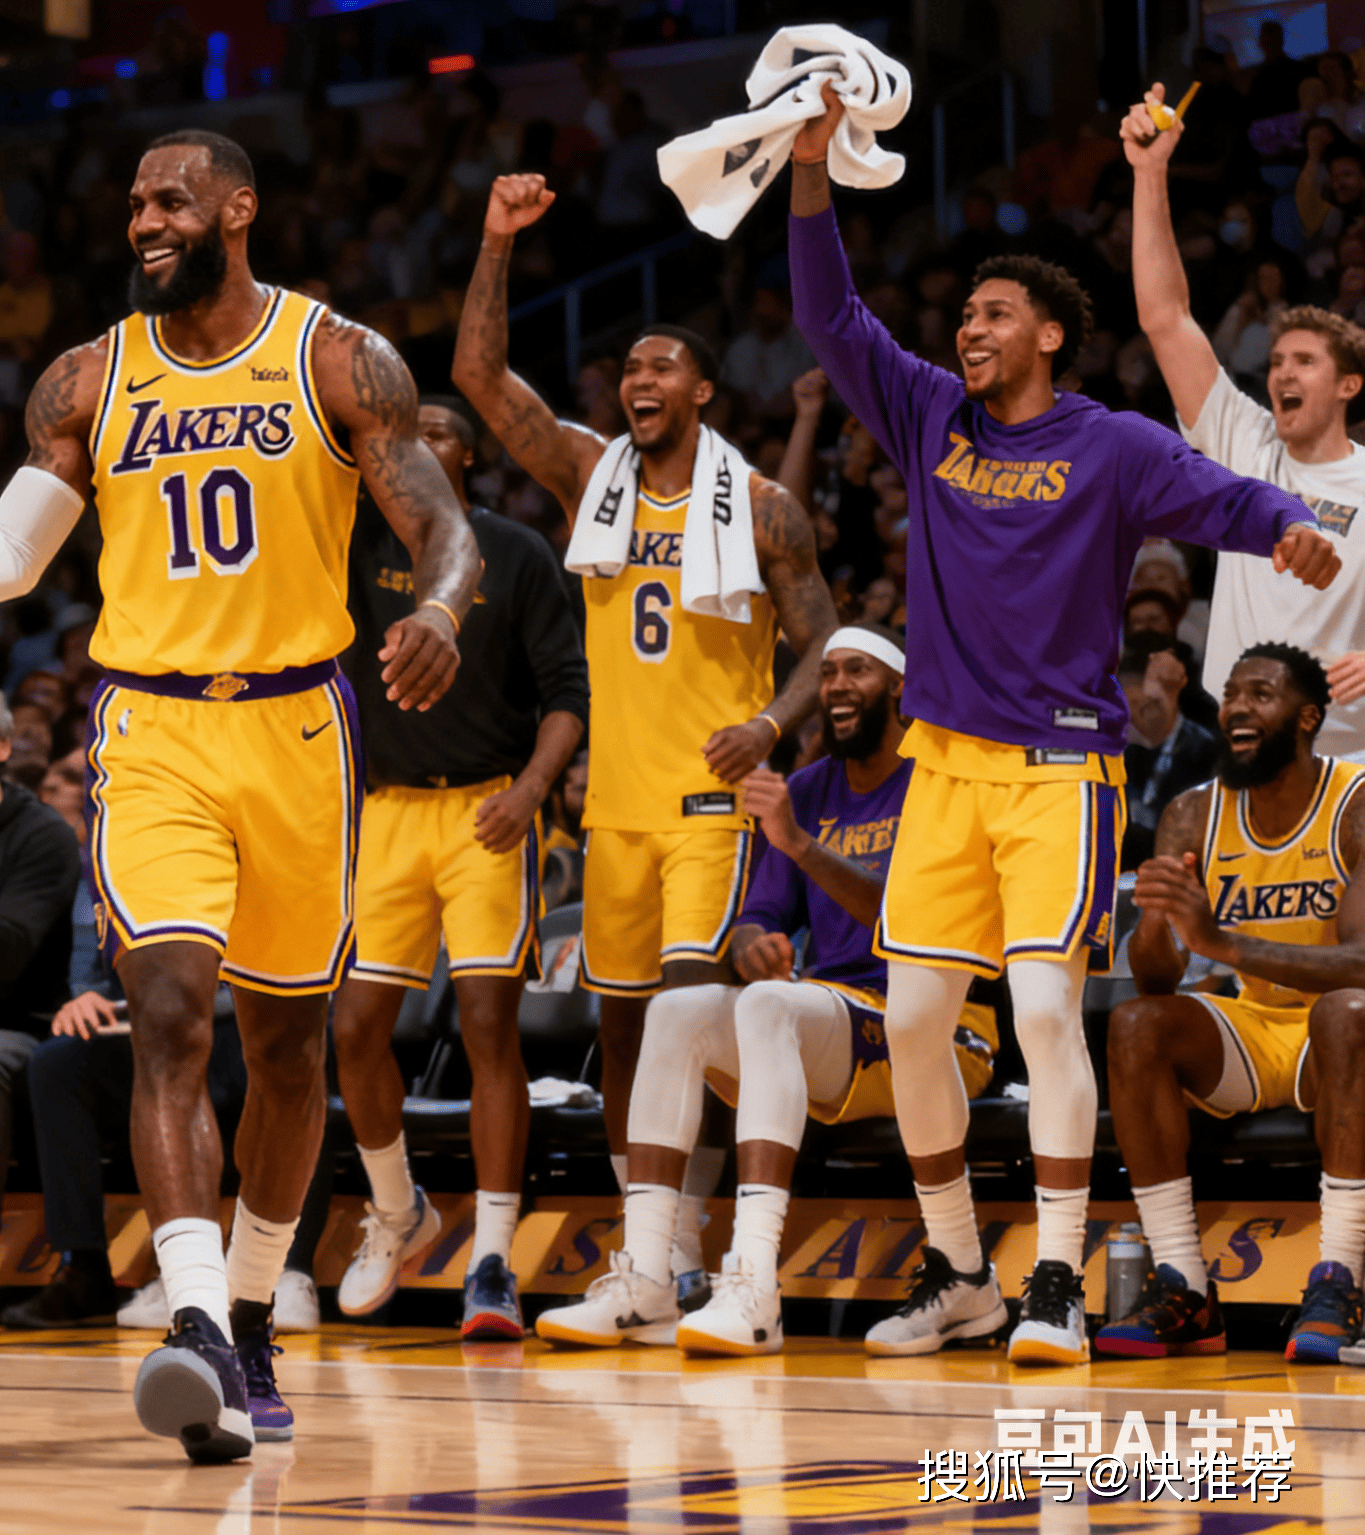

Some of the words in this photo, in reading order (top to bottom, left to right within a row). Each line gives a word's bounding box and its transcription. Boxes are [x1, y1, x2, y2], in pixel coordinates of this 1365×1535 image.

[109, 399, 295, 477] LAKERS
[160, 466, 259, 580] 10
[629, 530, 683, 567] AKE
[632, 580, 673, 664] 6
[1214, 874, 1339, 928] LAKERS
